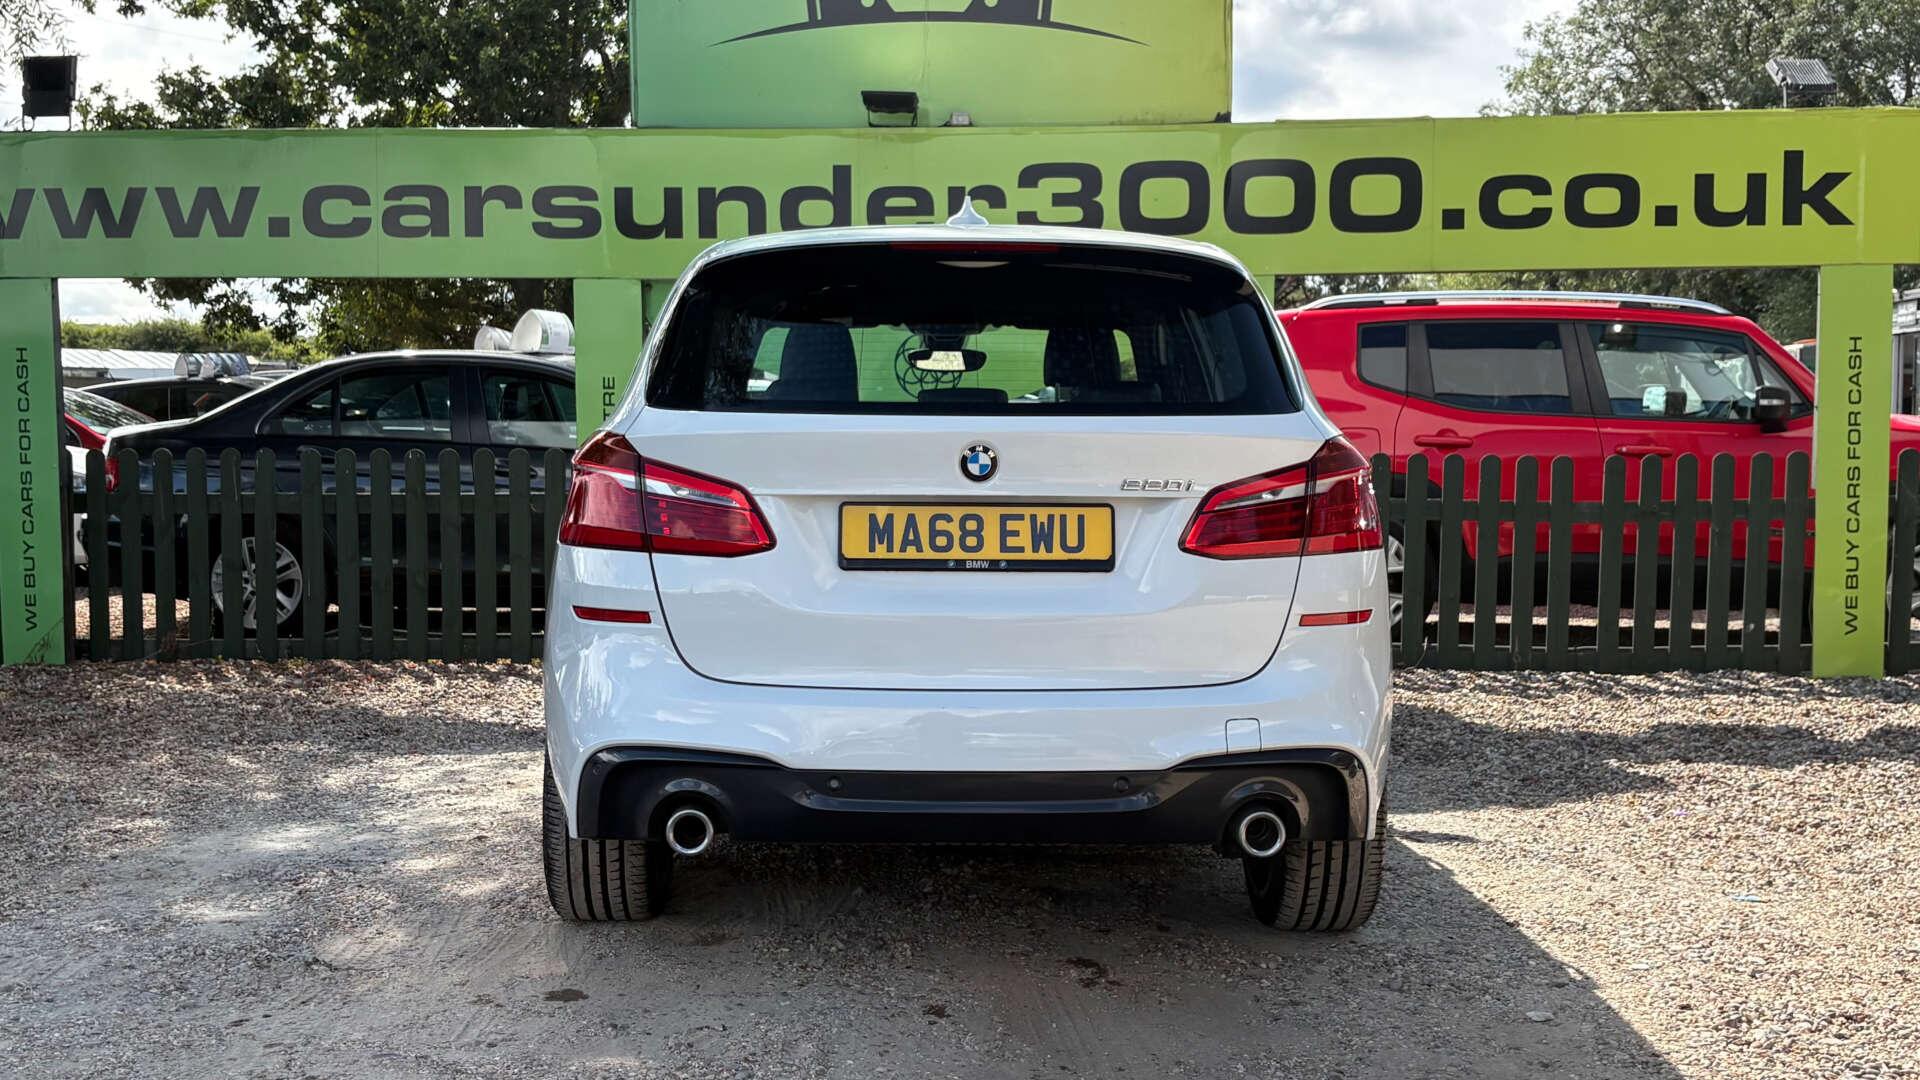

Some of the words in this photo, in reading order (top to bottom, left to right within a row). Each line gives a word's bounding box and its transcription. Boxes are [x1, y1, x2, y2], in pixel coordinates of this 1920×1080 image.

[16, 347, 30, 412] CASH
[1848, 336, 1862, 405] CASH
[602, 376, 616, 421] TRE
[18, 418, 31, 465] FOR
[964, 445, 996, 458] BMW
[1847, 411, 1861, 460] FOR
[21, 470, 34, 535] CARS
[1846, 466, 1860, 534] CARS
[868, 512, 985, 554] MA68
[1000, 513, 1085, 554] EWU
[23, 542, 36, 588] BUY
[966, 560, 990, 569] BMW
[1845, 539, 1859, 590] BUY
[25, 594, 37, 632] WE
[1844, 595, 1858, 635] WE
